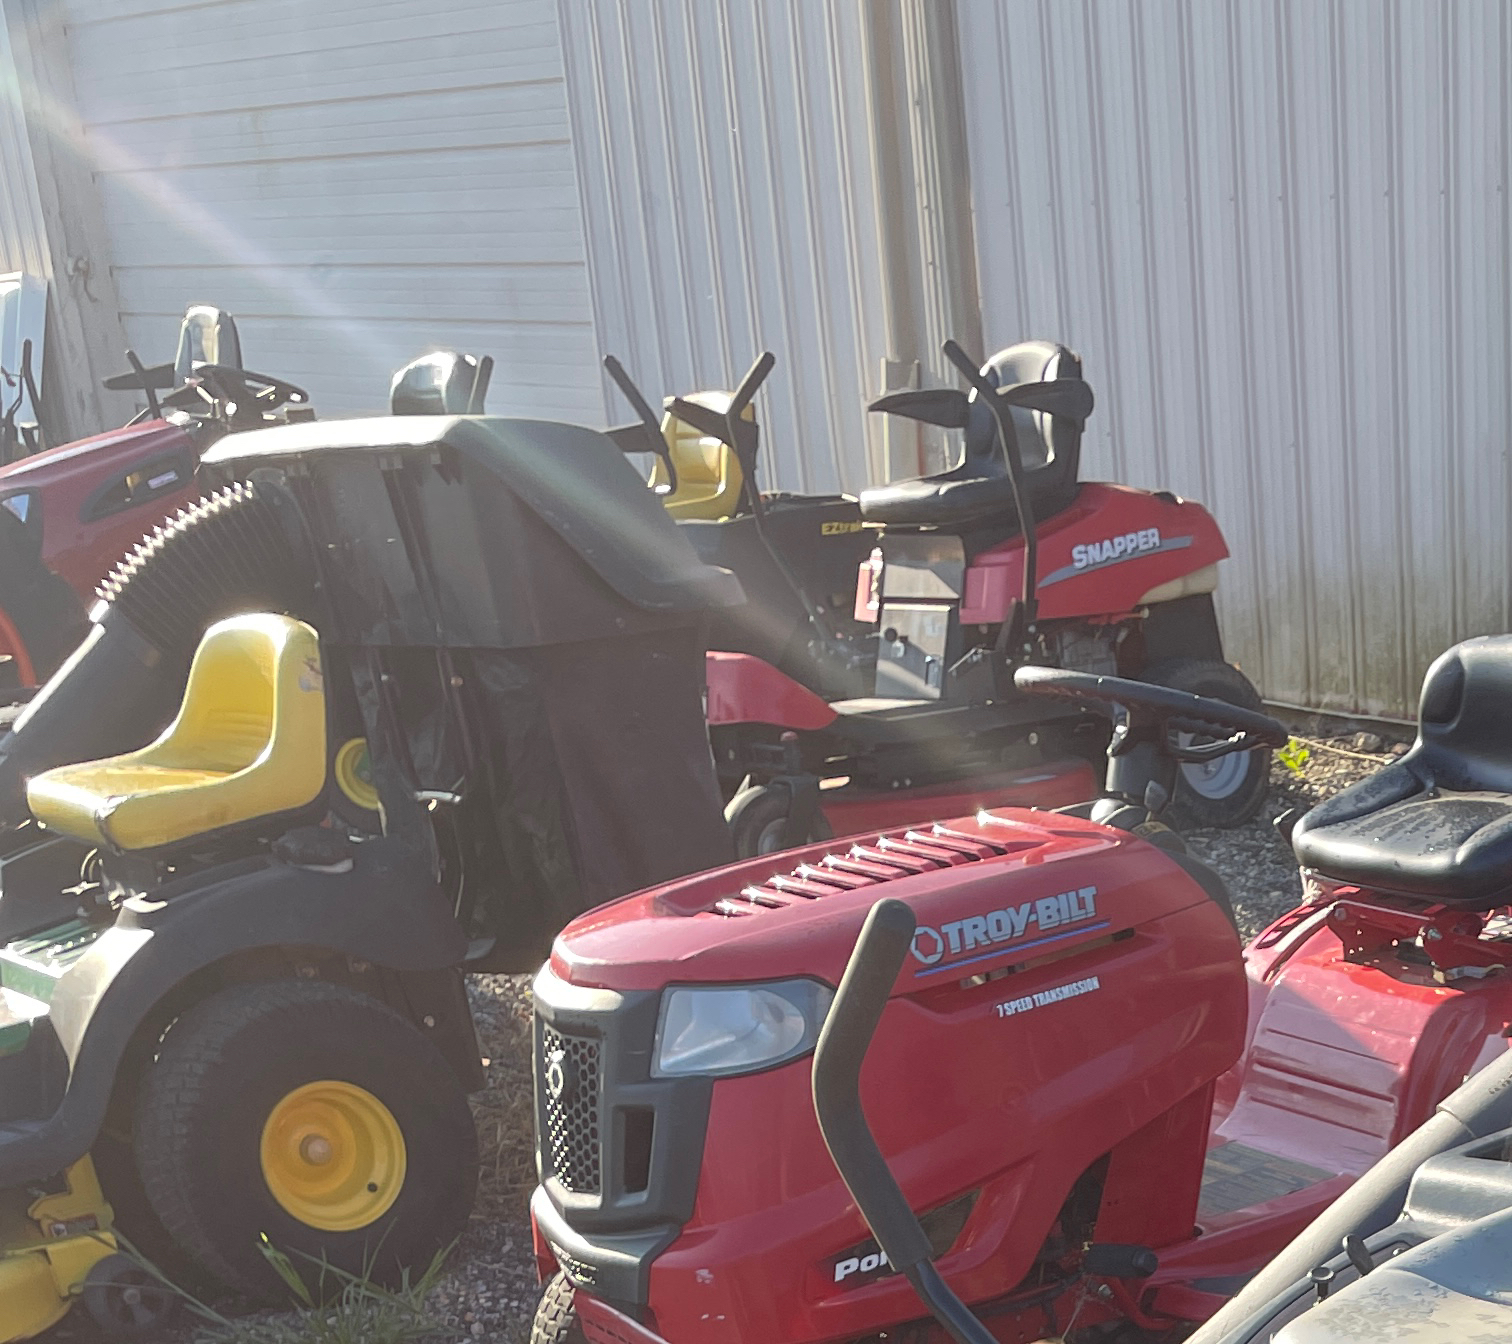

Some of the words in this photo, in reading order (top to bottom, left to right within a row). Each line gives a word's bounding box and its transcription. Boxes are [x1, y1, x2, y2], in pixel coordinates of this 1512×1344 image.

[1072, 528, 1160, 569] SNAPPER
[941, 886, 1097, 953] TROY-BILT
[1005, 996, 1033, 1016] SPEED
[1032, 976, 1100, 1007] TRANSMISSION
